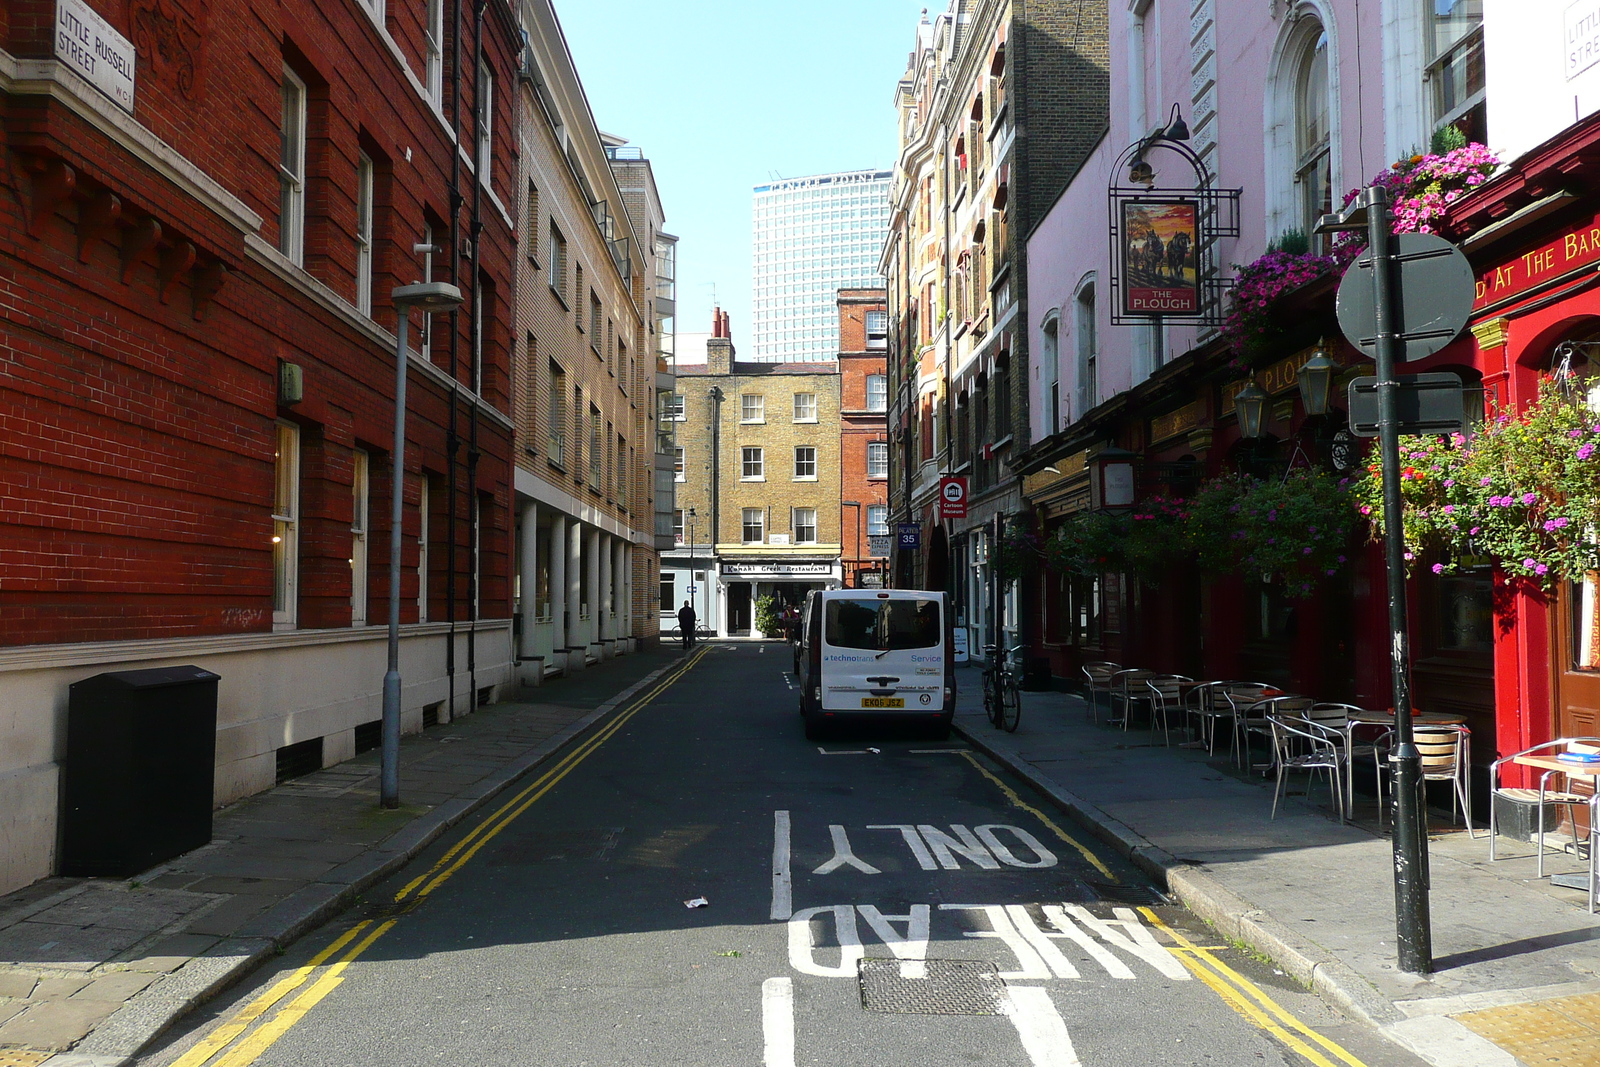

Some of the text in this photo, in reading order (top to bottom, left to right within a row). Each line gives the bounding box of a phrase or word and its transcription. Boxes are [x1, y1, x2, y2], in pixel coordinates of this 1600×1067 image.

[1568, 7, 1600, 44] LITTL
[60, 5, 132, 82] LITTLE RUSSELL
[59, 31, 96, 75] STREET
[830, 173, 876, 186] POINT
[1152, 290, 1172, 298] THE
[1133, 298, 1190, 309] PLOUGH
[902, 535, 915, 543] 35
[830, 654, 874, 662] technotrans
[911, 654, 941, 662] Service
[886, 699, 901, 707] JSZ
[812, 824, 1058, 875] ONLY
[788, 902, 1192, 980] AHEAD
